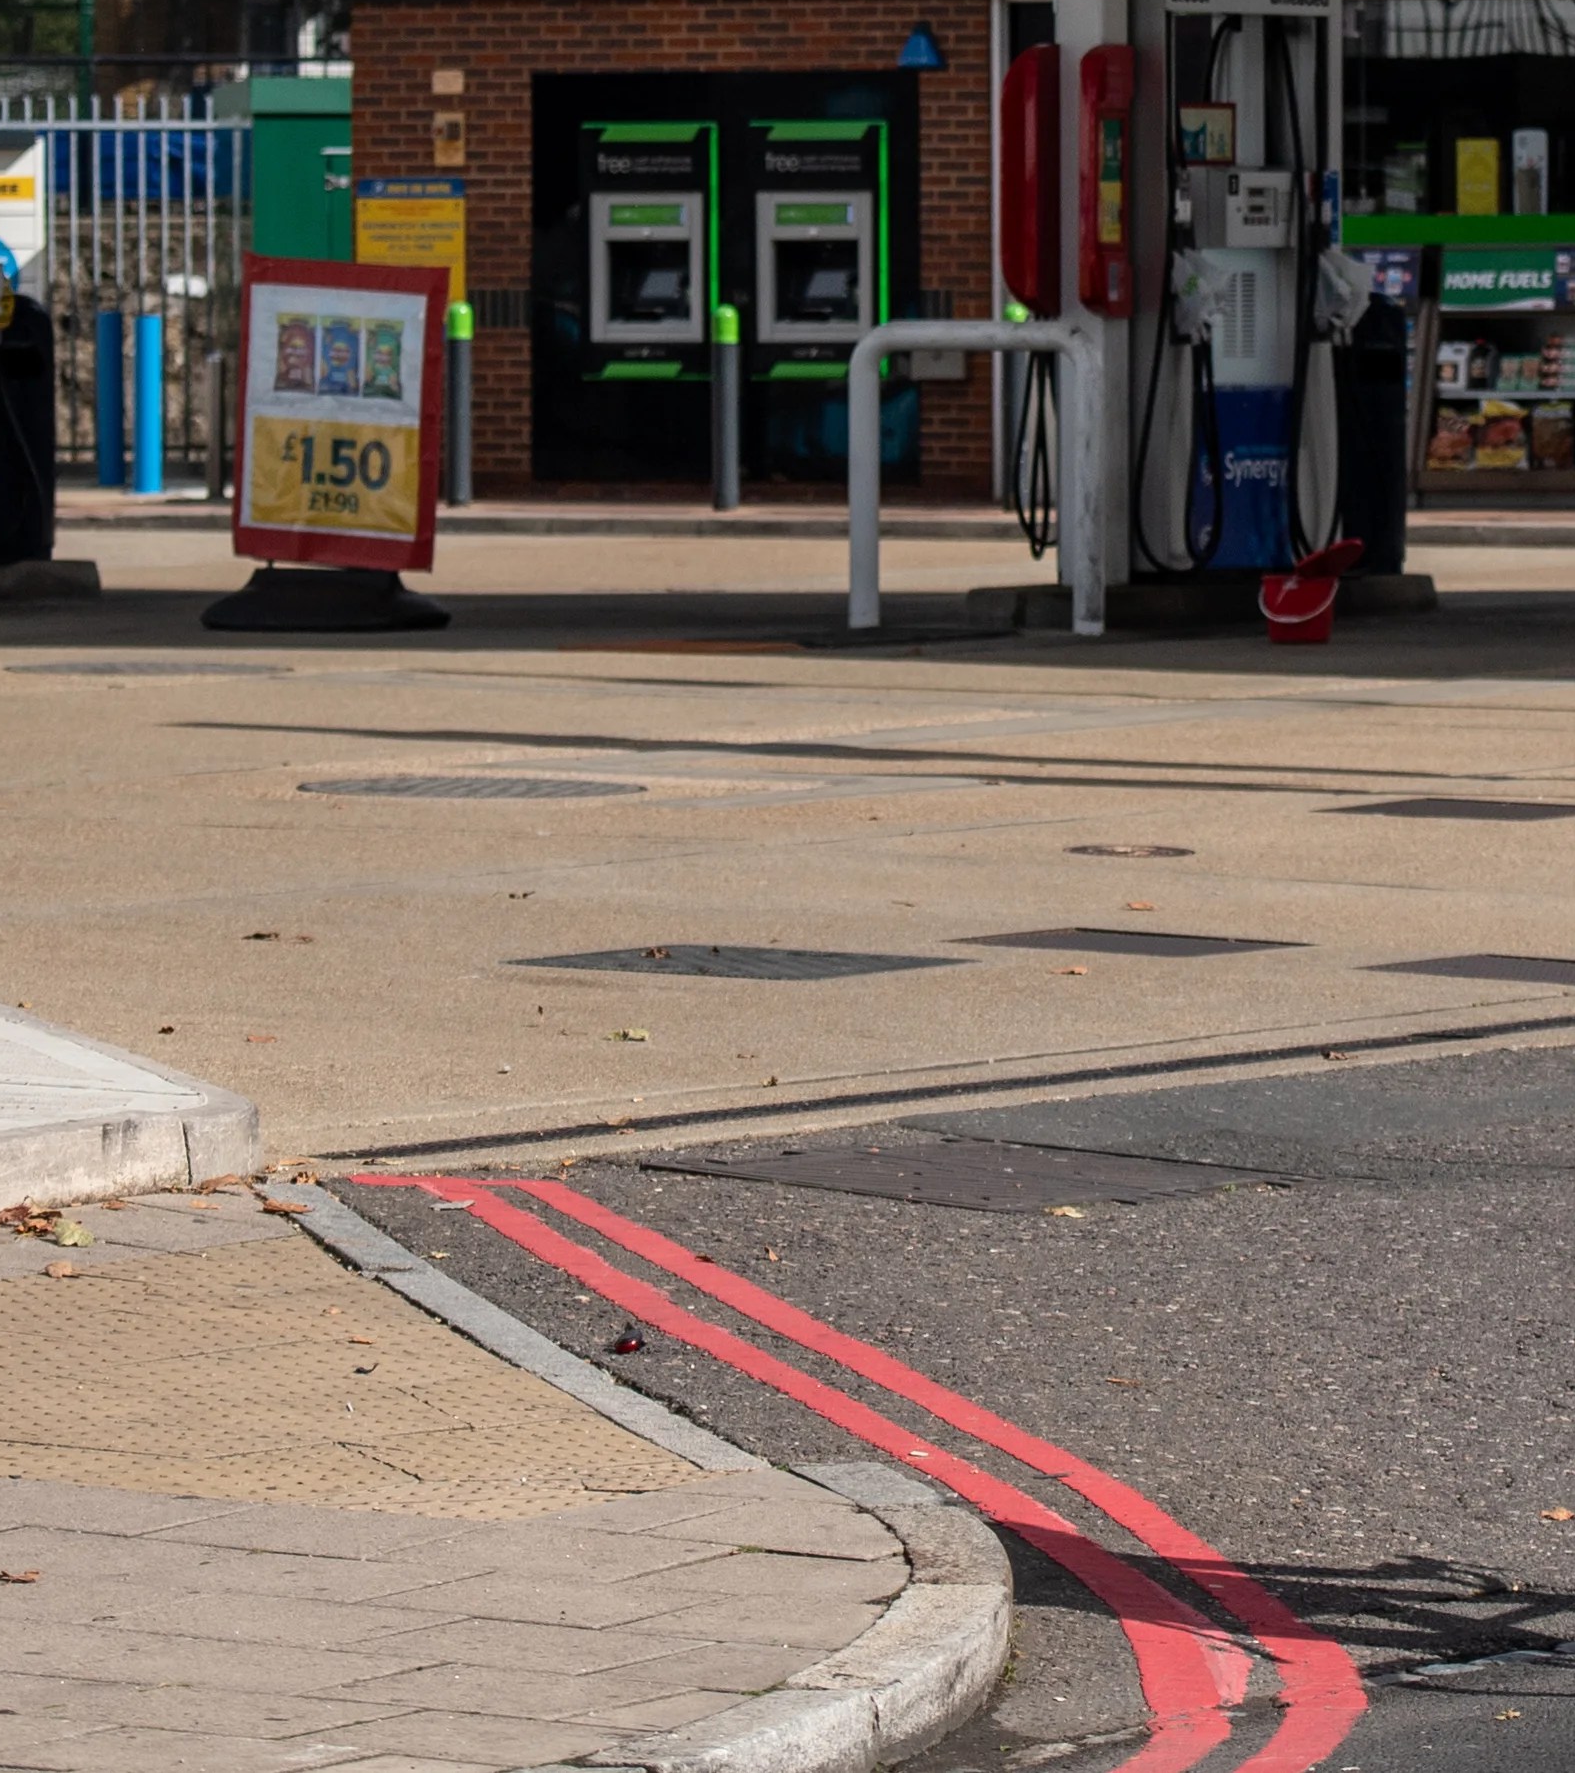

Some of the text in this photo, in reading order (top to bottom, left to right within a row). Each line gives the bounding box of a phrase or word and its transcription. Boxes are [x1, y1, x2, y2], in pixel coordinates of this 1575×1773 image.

[597, 151, 633, 174] free
[764, 151, 801, 173] free
[1443, 268, 1553, 291] HOME FUELS
[281, 432, 392, 491] £1.50
[1224, 453, 1289, 487] Synergy
